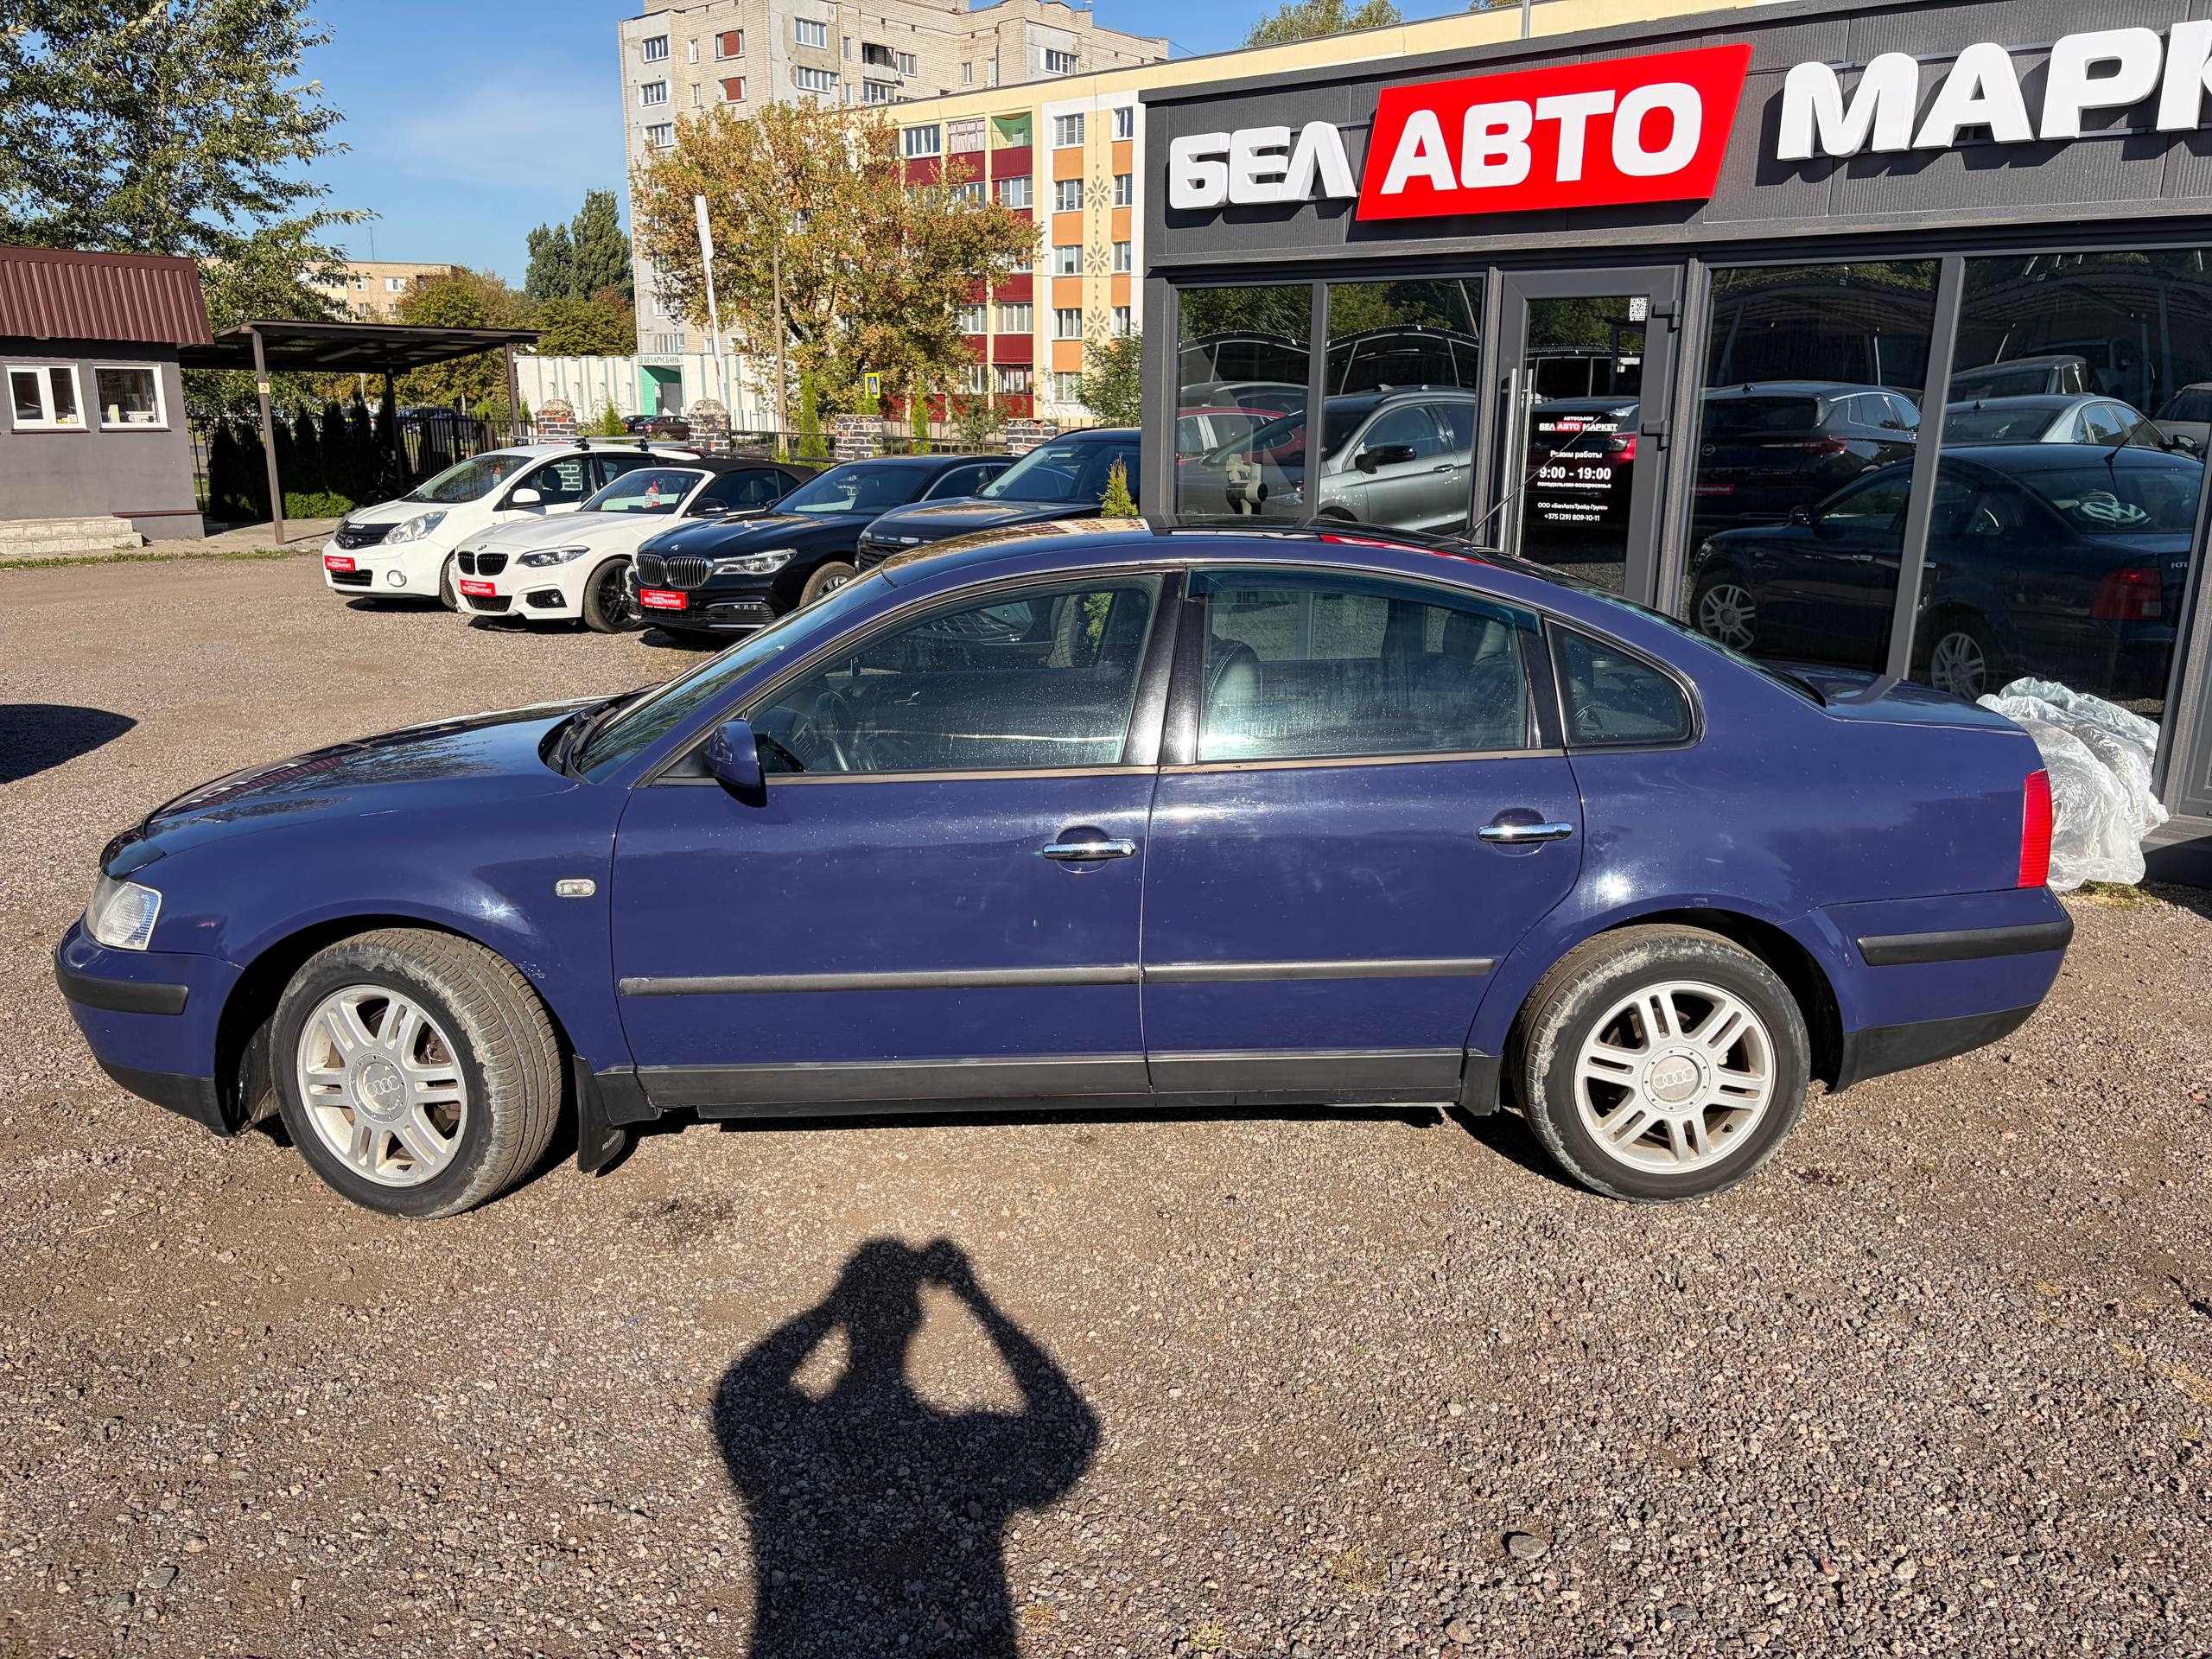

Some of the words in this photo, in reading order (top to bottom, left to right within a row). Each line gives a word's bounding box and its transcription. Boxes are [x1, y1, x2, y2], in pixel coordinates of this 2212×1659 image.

[1169, 120, 1357, 210] БЕЛ
[1380, 82, 1703, 195] АВТО
[1539, 423, 1555, 431] БЕЛ
[1574, 450, 1603, 459] работы
[1539, 467, 1566, 479] 9:00
[1577, 467, 1611, 480] 19:00
